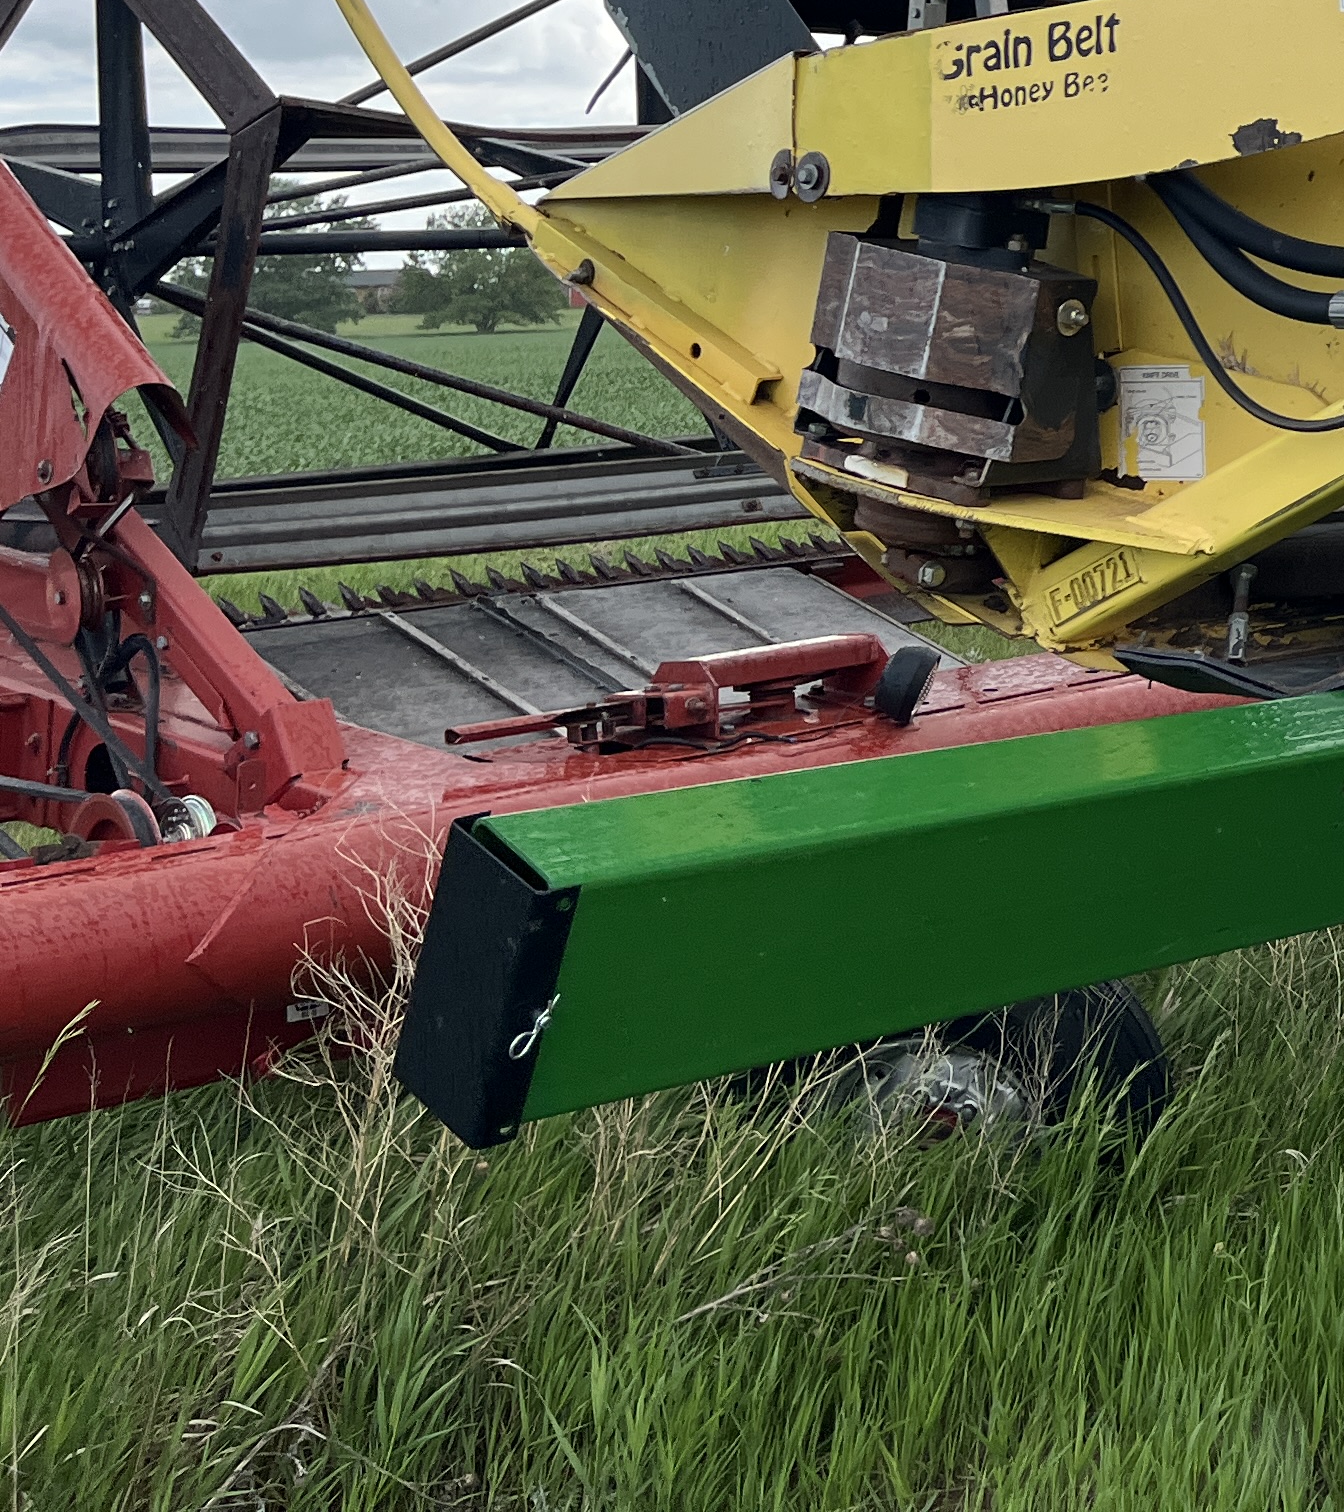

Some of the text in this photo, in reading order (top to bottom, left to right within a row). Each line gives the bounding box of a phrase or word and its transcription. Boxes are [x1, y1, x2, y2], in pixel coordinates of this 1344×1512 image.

[1048, 13, 1121, 62] Belt
[979, 80, 1054, 112] Honey
[1049, 551, 1135, 621] F-00721
